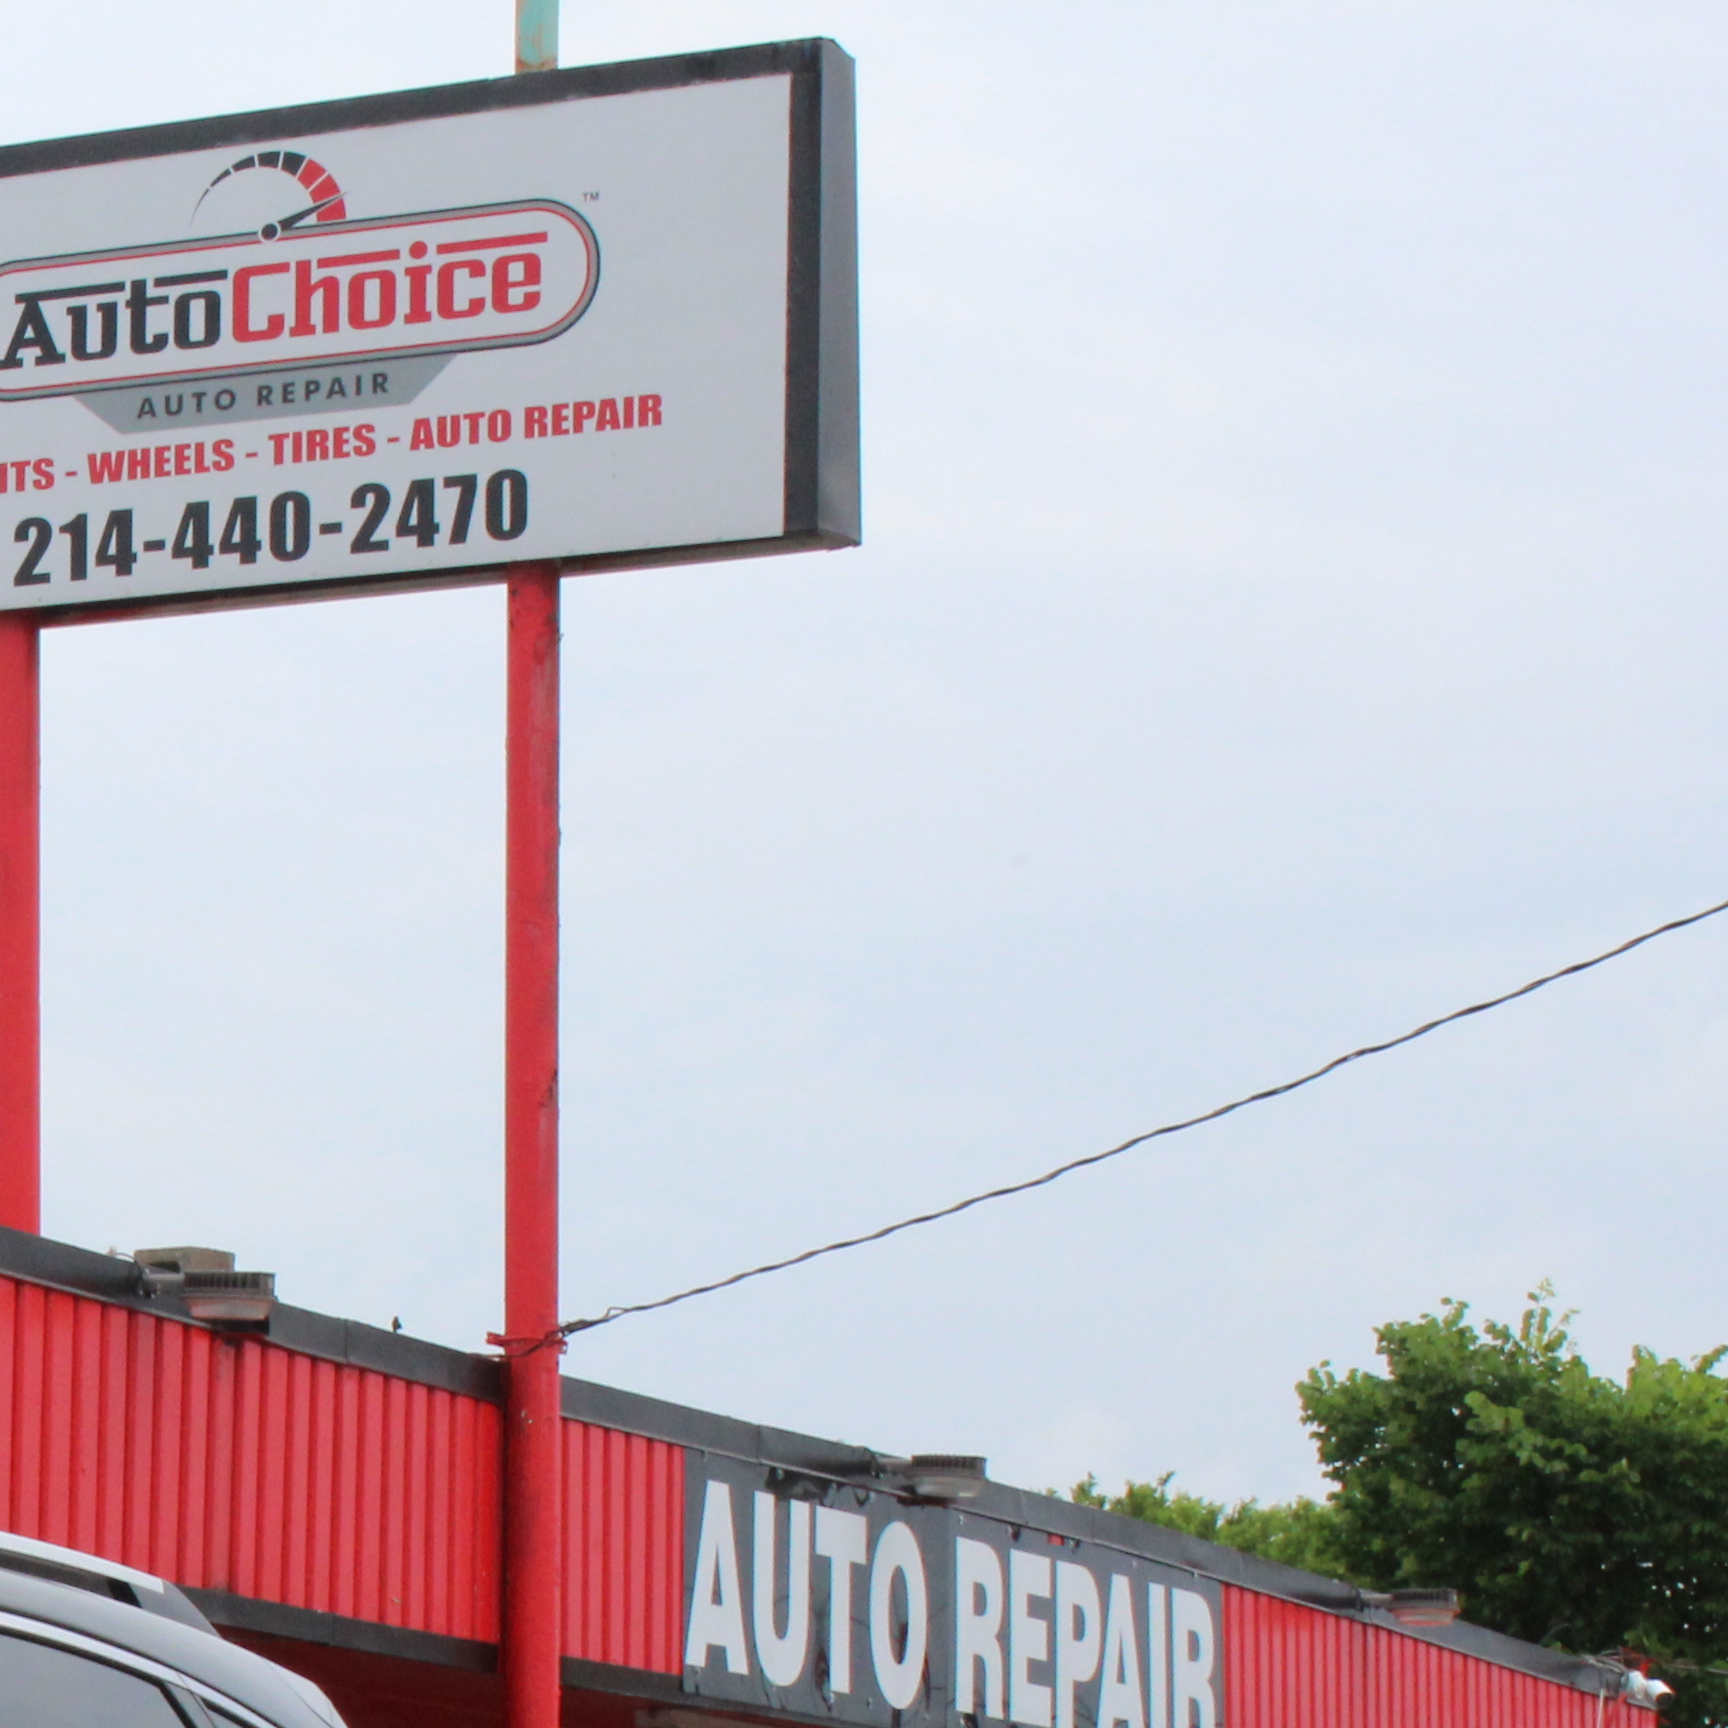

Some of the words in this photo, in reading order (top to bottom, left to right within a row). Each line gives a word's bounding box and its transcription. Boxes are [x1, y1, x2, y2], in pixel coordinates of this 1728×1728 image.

[87, 439, 236, 485] WHEELS
[268, 423, 377, 466] TIRES
[409, 409, 513, 451] AUTO
[524, 394, 663, 440] REPAIR
[137, 389, 236, 419] AUTO
[257, 372, 389, 406] REPAIR
[12, 469, 529, 588] 214-440-2470
[685, 1480, 927, 1709] AUTO
